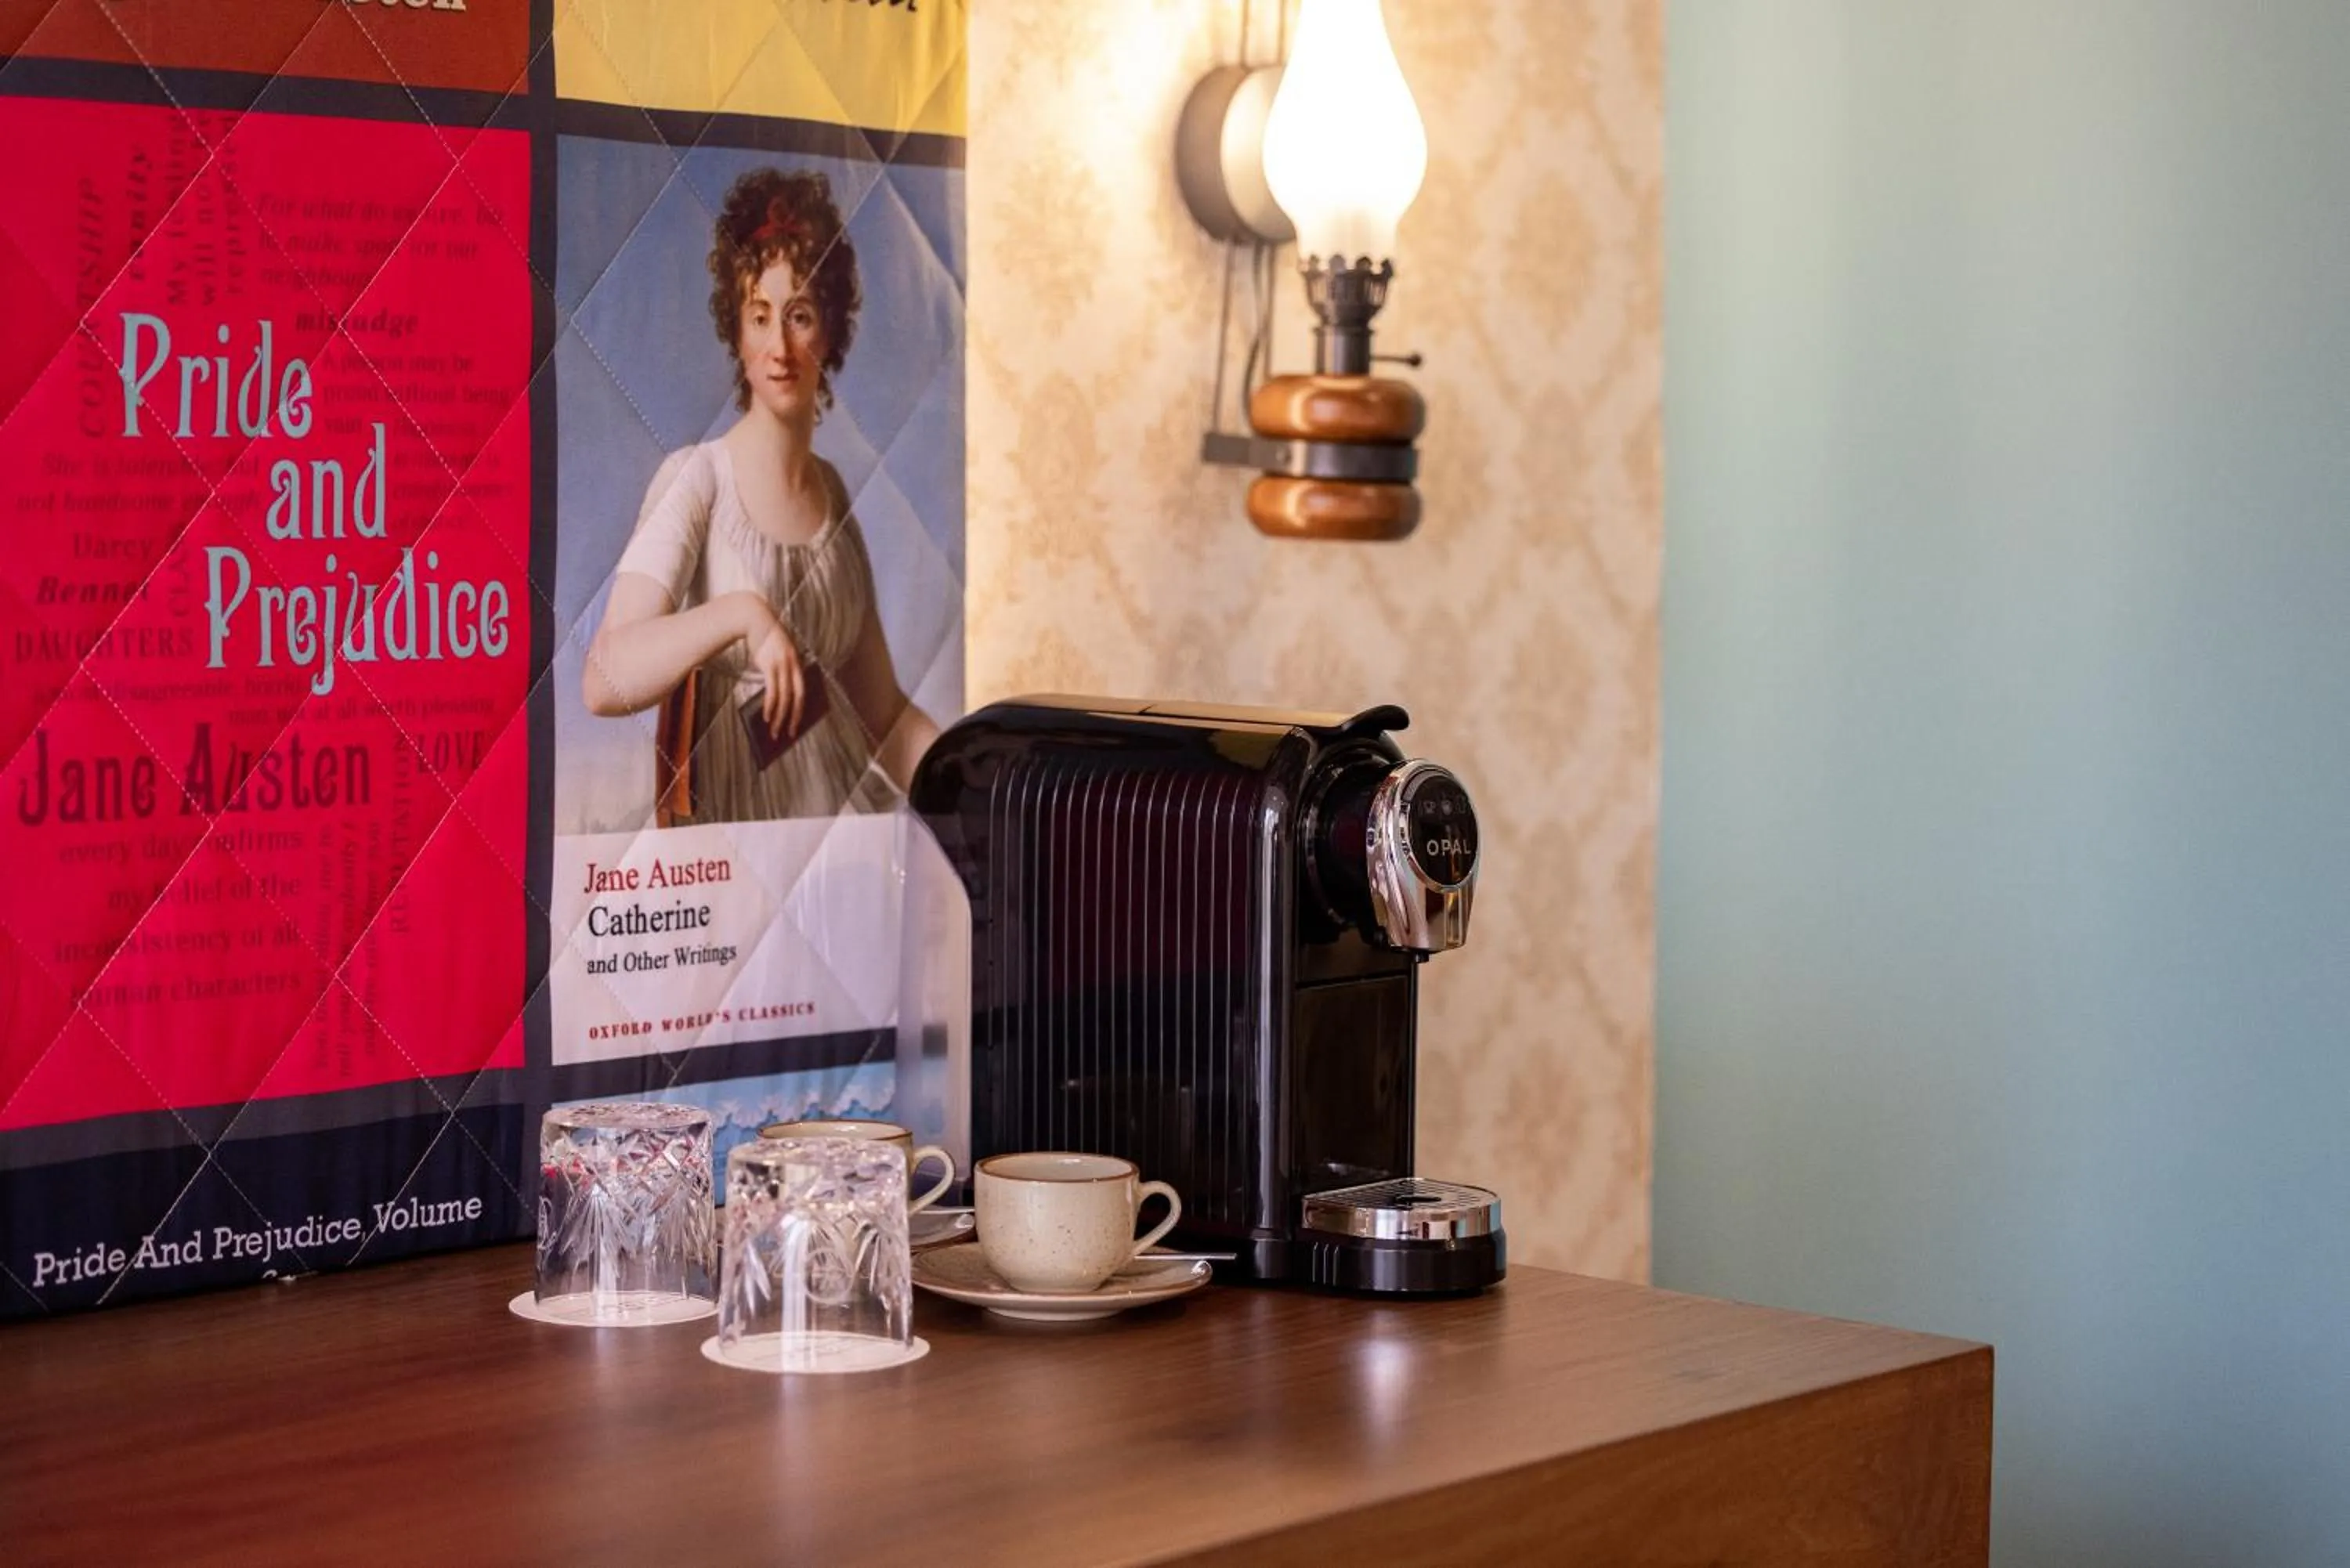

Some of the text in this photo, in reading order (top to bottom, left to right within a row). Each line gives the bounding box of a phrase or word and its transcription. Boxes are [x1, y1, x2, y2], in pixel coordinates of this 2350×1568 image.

[118, 313, 313, 438] Pride
[266, 422, 388, 540] and
[204, 544, 510, 696] Prejudice
[17, 721, 371, 827] Jane Austen
[584, 858, 732, 894] Jane Austen
[1426, 840, 1471, 856] OPAL
[588, 900, 710, 938] Catherine
[587, 942, 737, 974] and Other Writings
[589, 1002, 816, 1040] OXFORD WORLD'S CLASSICS
[33, 1243, 125, 1288] Pride
[134, 1230, 201, 1268] And
[373, 1196, 483, 1234] Volume
